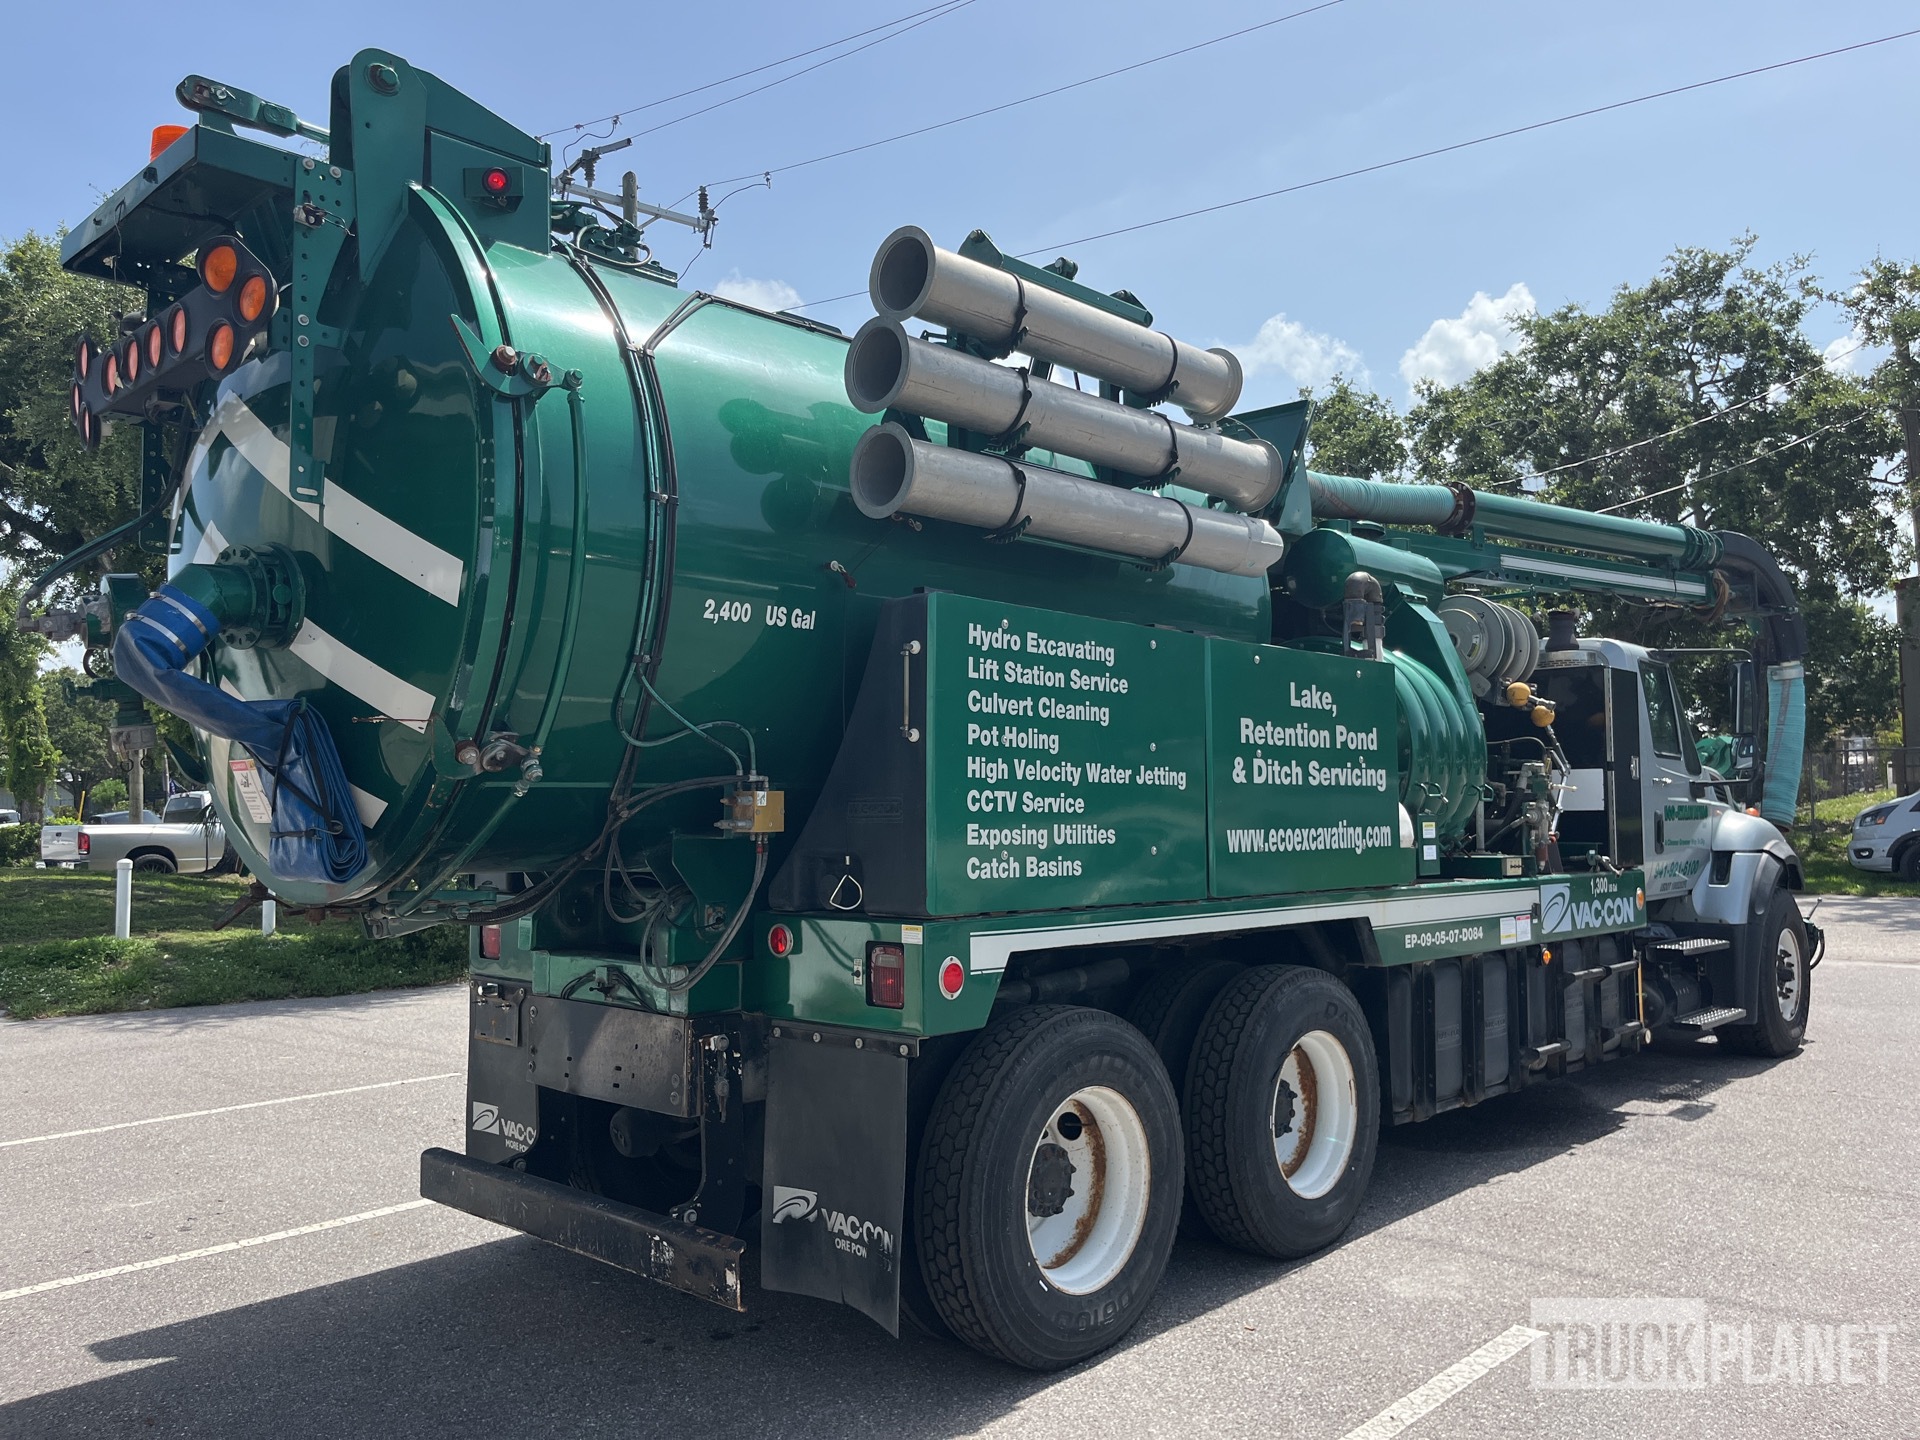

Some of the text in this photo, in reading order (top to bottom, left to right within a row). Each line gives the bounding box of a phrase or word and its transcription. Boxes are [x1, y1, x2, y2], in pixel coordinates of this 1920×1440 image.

[703, 599, 816, 630] 2,400 US Gal
[968, 623, 1115, 667] Hydro Excavating
[968, 656, 1129, 694] Lift Station Service
[967, 690, 1110, 727] Culvert Cleaning
[1290, 681, 1337, 717] Lake,
[967, 723, 1059, 755] Pot Holing
[1240, 717, 1378, 751] Retention Pond
[967, 756, 1187, 790] High Velocity Water Jetting
[1232, 756, 1387, 792] & Ditch Servicing
[966, 789, 1085, 814] CCTV Service
[966, 823, 1116, 850] Exposing Utilities
[1226, 819, 1392, 855] www.ecoexcavating.com
[966, 856, 1082, 880] Catch Basins
[1590, 877, 1608, 897] 1,300
[1404, 926, 1483, 949] EP-09-05-07-D084
